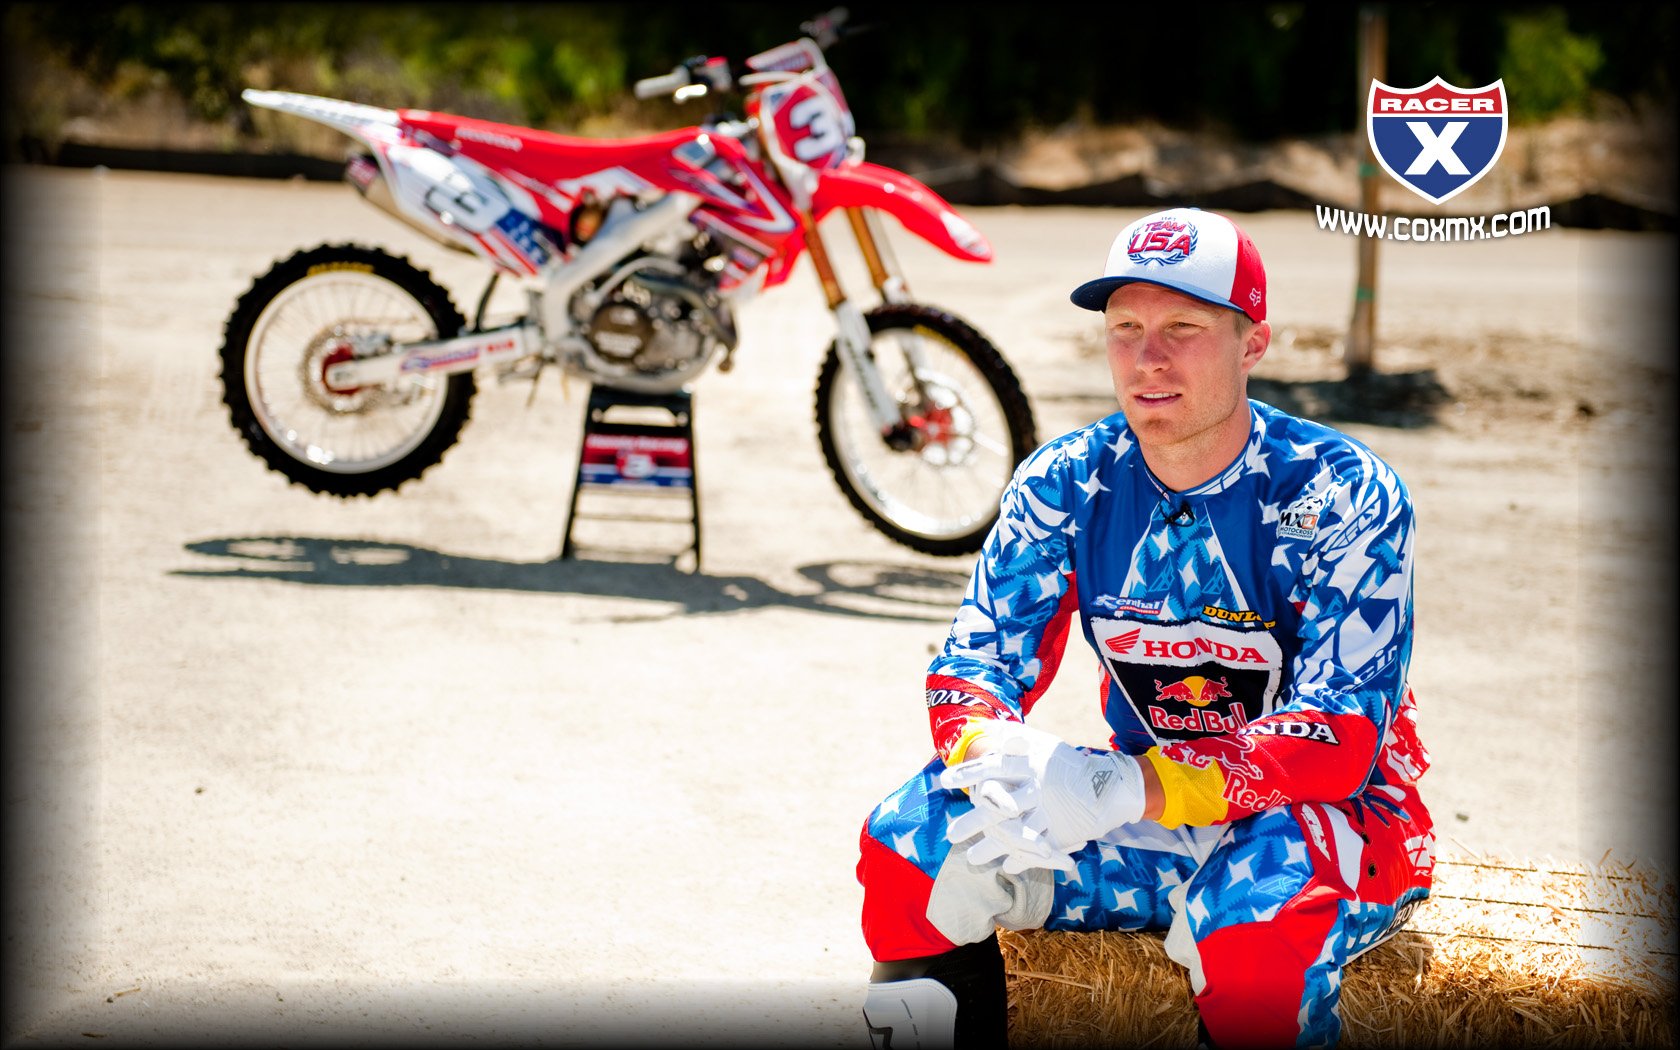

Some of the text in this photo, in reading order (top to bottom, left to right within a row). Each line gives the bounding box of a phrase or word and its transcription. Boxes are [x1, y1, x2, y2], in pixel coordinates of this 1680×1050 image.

[790, 95, 848, 161] 3
[1145, 221, 1186, 232] TEAM
[1127, 231, 1191, 256] USA
[1143, 637, 1269, 664] HONDA
